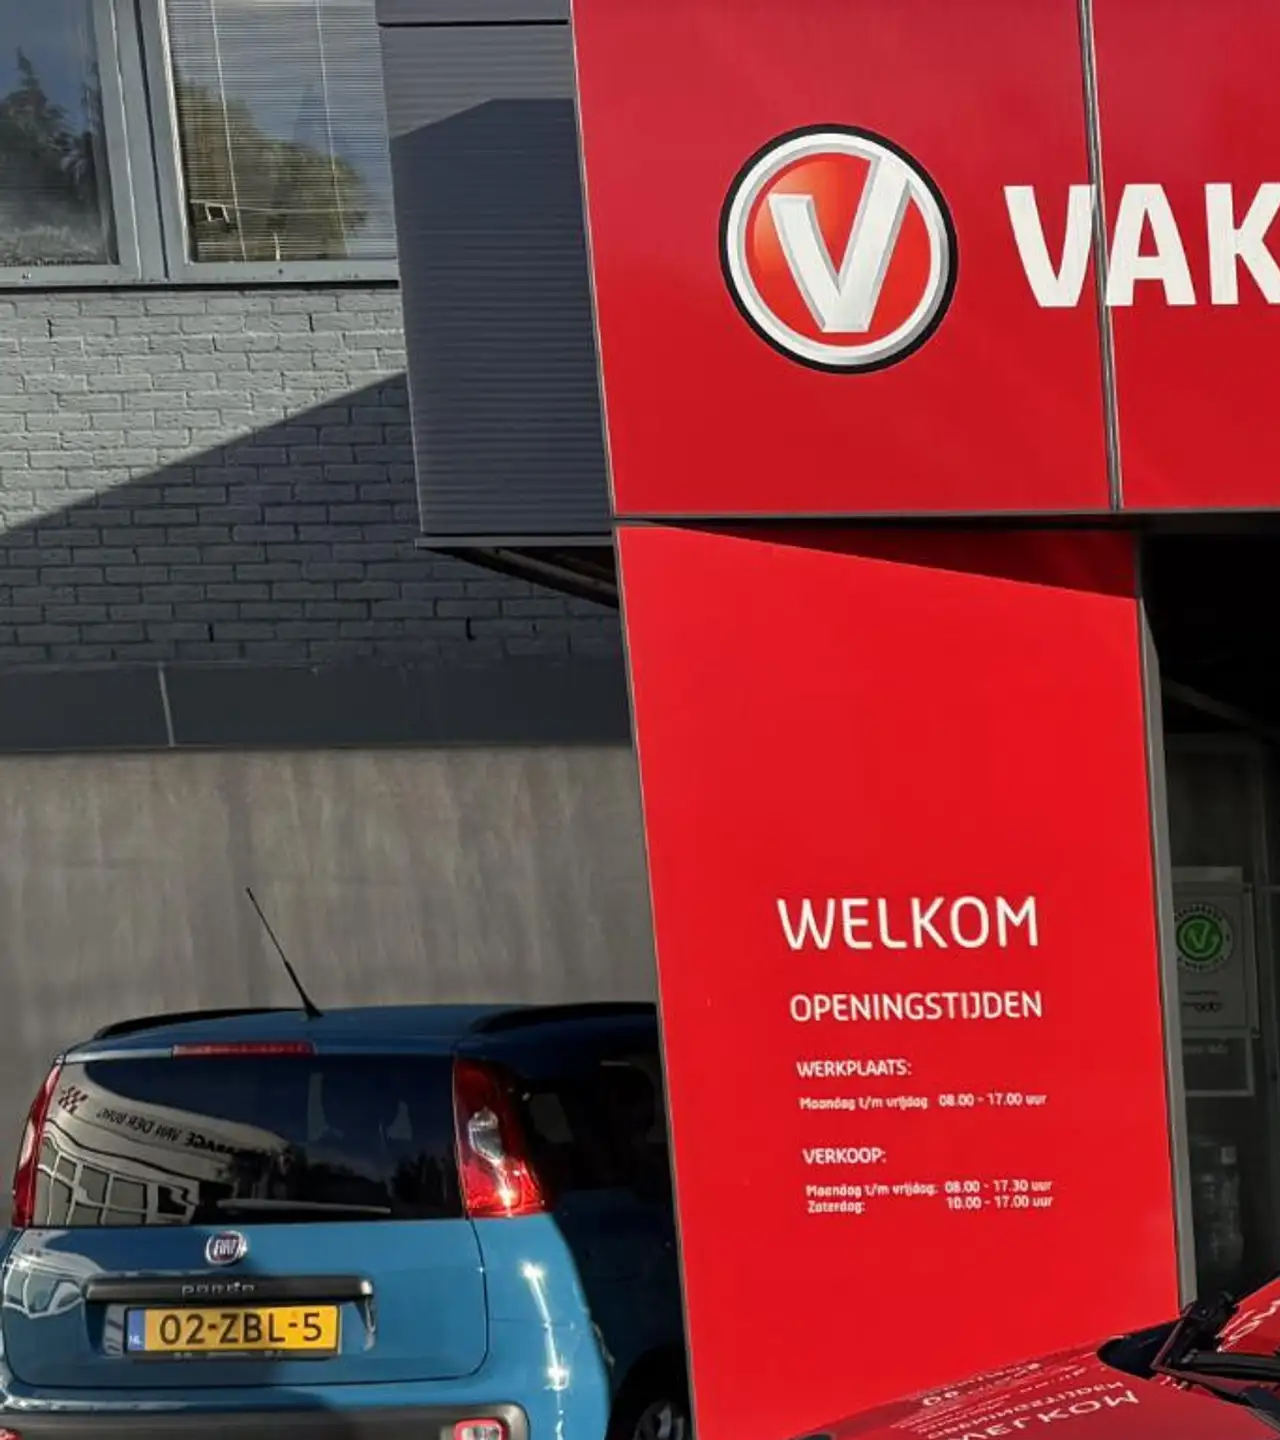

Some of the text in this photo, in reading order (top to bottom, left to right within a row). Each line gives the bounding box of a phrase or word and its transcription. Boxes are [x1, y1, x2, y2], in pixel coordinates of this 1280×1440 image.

[777, 895, 1039, 950] WELKOM
[790, 991, 1043, 1022] OPENINGSTIJDEN
[796, 1058, 912, 1078] WERKPLAATS:
[800, 1096, 856, 1110] Maandag
[858, 1096, 883, 1110] t/m
[939, 1093, 974, 1107] 08.00
[986, 1092, 1023, 1106] 17.00
[1026, 1094, 1047, 1105] uur
[802, 1146, 887, 1165] VERKOOP:
[805, 1184, 862, 1198] Maandag
[864, 1184, 890, 1196] t/m
[944, 1180, 980, 1193] 08.00
[993, 1179, 1029, 1192] 17.30
[1031, 1181, 1053, 1192] uur
[807, 1200, 866, 1214] Zaterdag:
[946, 1196, 982, 1209] 10.00
[994, 1195, 1029, 1208] 17.00
[1032, 1196, 1054, 1207] uur
[158, 1312, 323, 1345] 02-ZBL-5
[128, 1334, 142, 1346] NL
